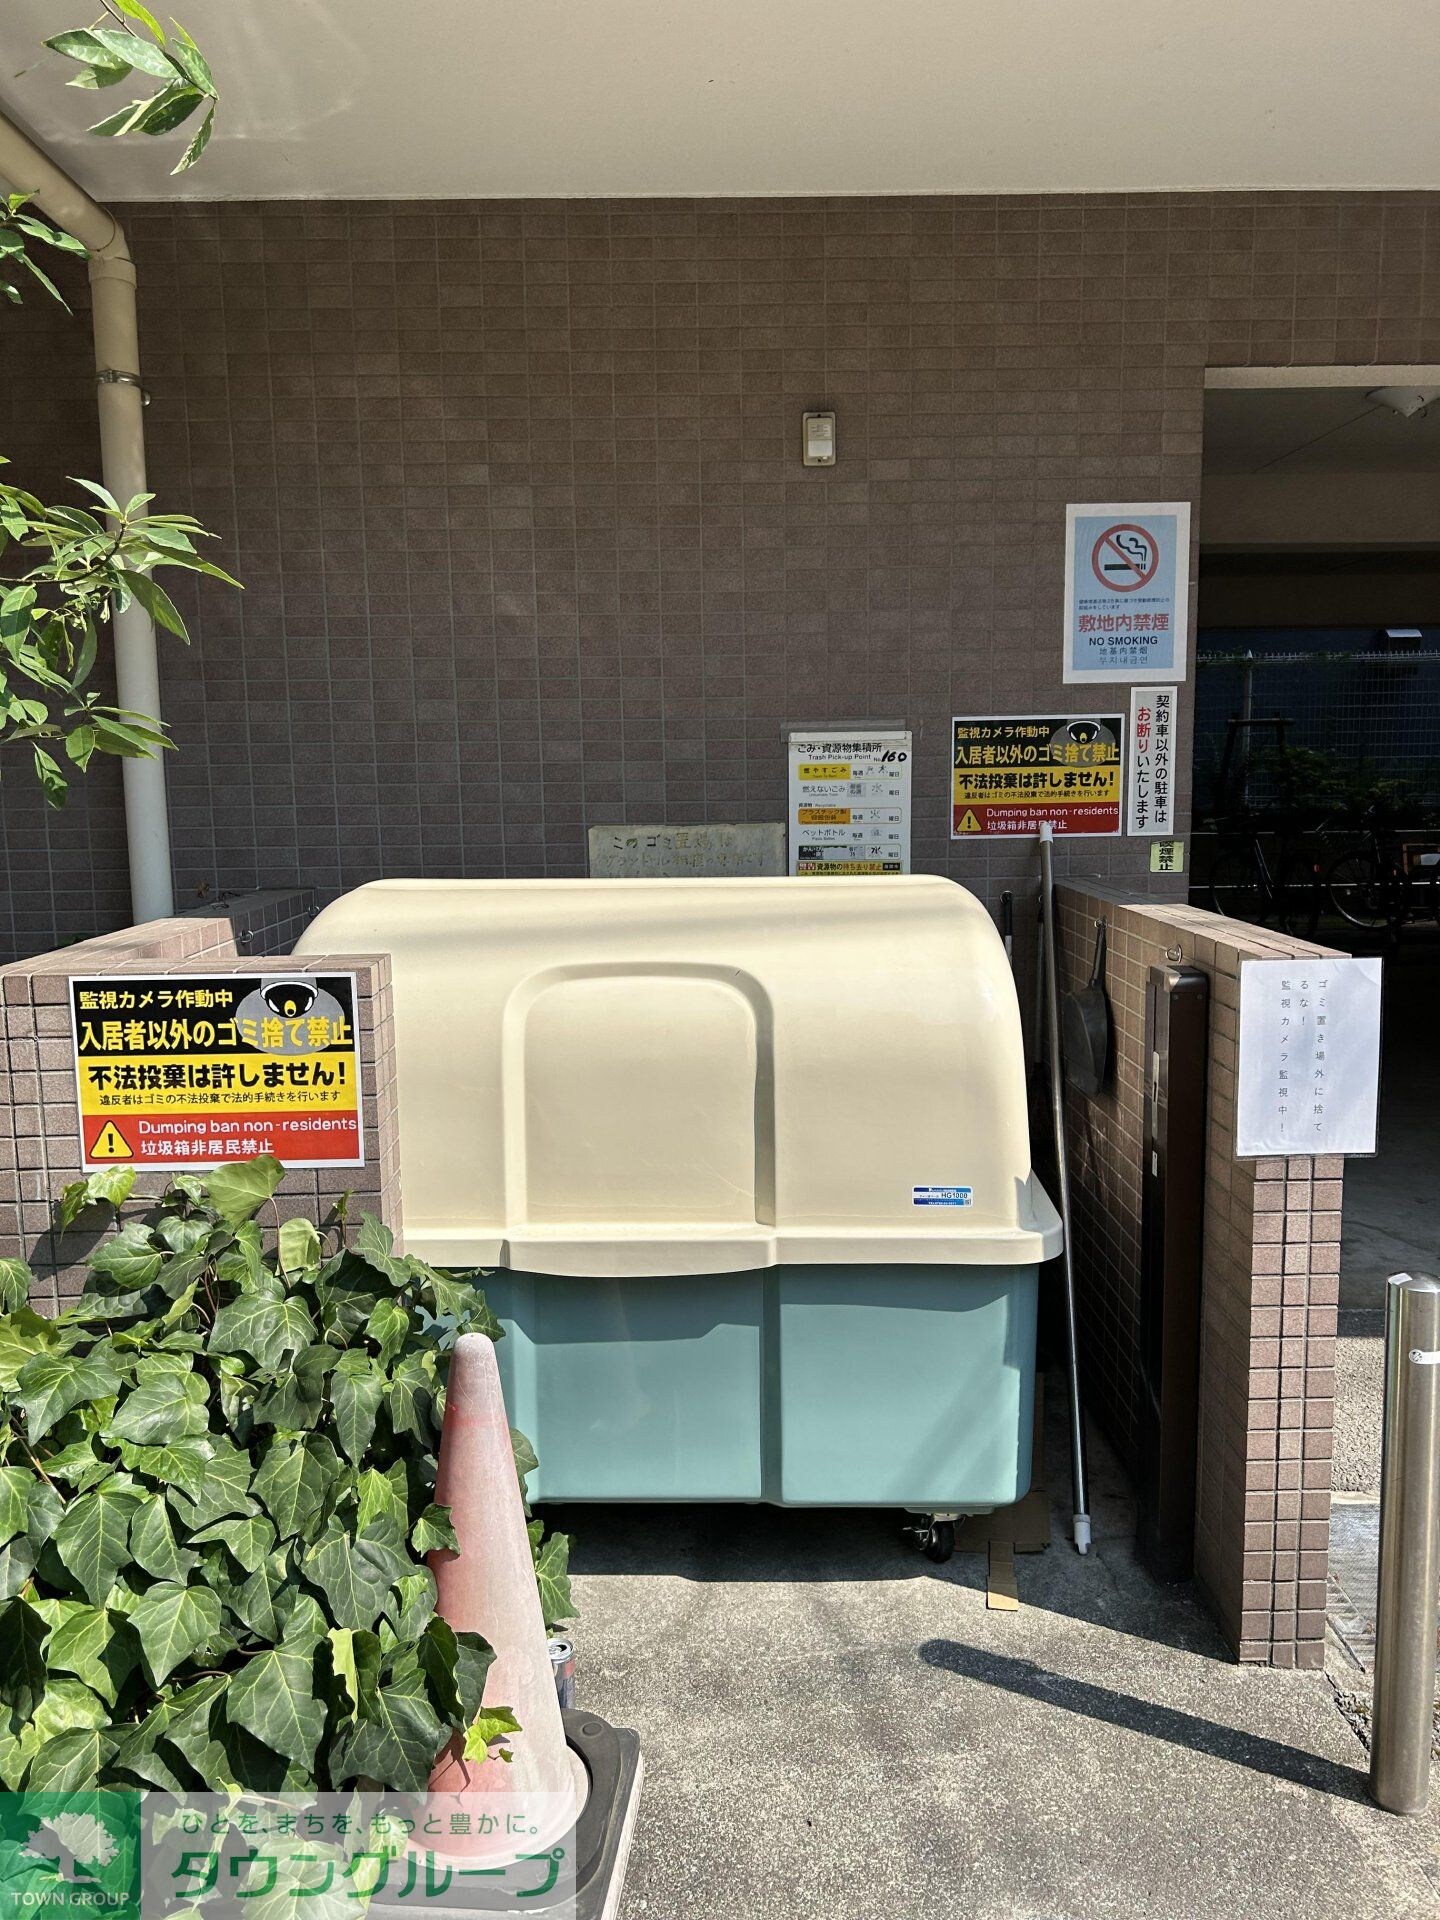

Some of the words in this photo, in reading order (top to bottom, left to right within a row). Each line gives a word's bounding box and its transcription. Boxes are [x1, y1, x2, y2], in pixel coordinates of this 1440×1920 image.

[1079, 613, 1170, 633] 敷地内禁煙
[1089, 637, 1104, 646] NO
[1108, 635, 1158, 646] SMOKING
[957, 726, 1050, 740] 監視カメラ作動中
[797, 743, 882, 754] ごみ・資源物集積所
[828, 753, 853, 761] Pick-up
[955, 744, 1120, 766] 入居者以外のゴミ捨て禁止
[1136, 706, 1152, 829] お断りいたします
[1155, 694, 1170, 823] 契約車以外の駐車は
[959, 771, 1115, 790] 不法投棄は許しません!
[987, 808, 1027, 818] Dumping
[1029, 807, 1048, 816] ban
[802, 829, 846, 837] ペットボトル
[79, 989, 234, 1011] 監視カメラ作動中
[78, 1017, 353, 1051] 入居者以外のゴミ捨て禁止
[1313, 979, 1329, 1132] ゴミ置き場外に捨て
[88, 1061, 345, 1091] 不法投棄は許しません!
[99, 1090, 341, 1106] 違反者はゴミの不法投棄で法的手続きを行います
[139, 1119, 207, 1135] Dumping
[210, 1119, 238, 1133] ban
[140, 1138, 275, 1156] 垃圾箱非居民禁止
